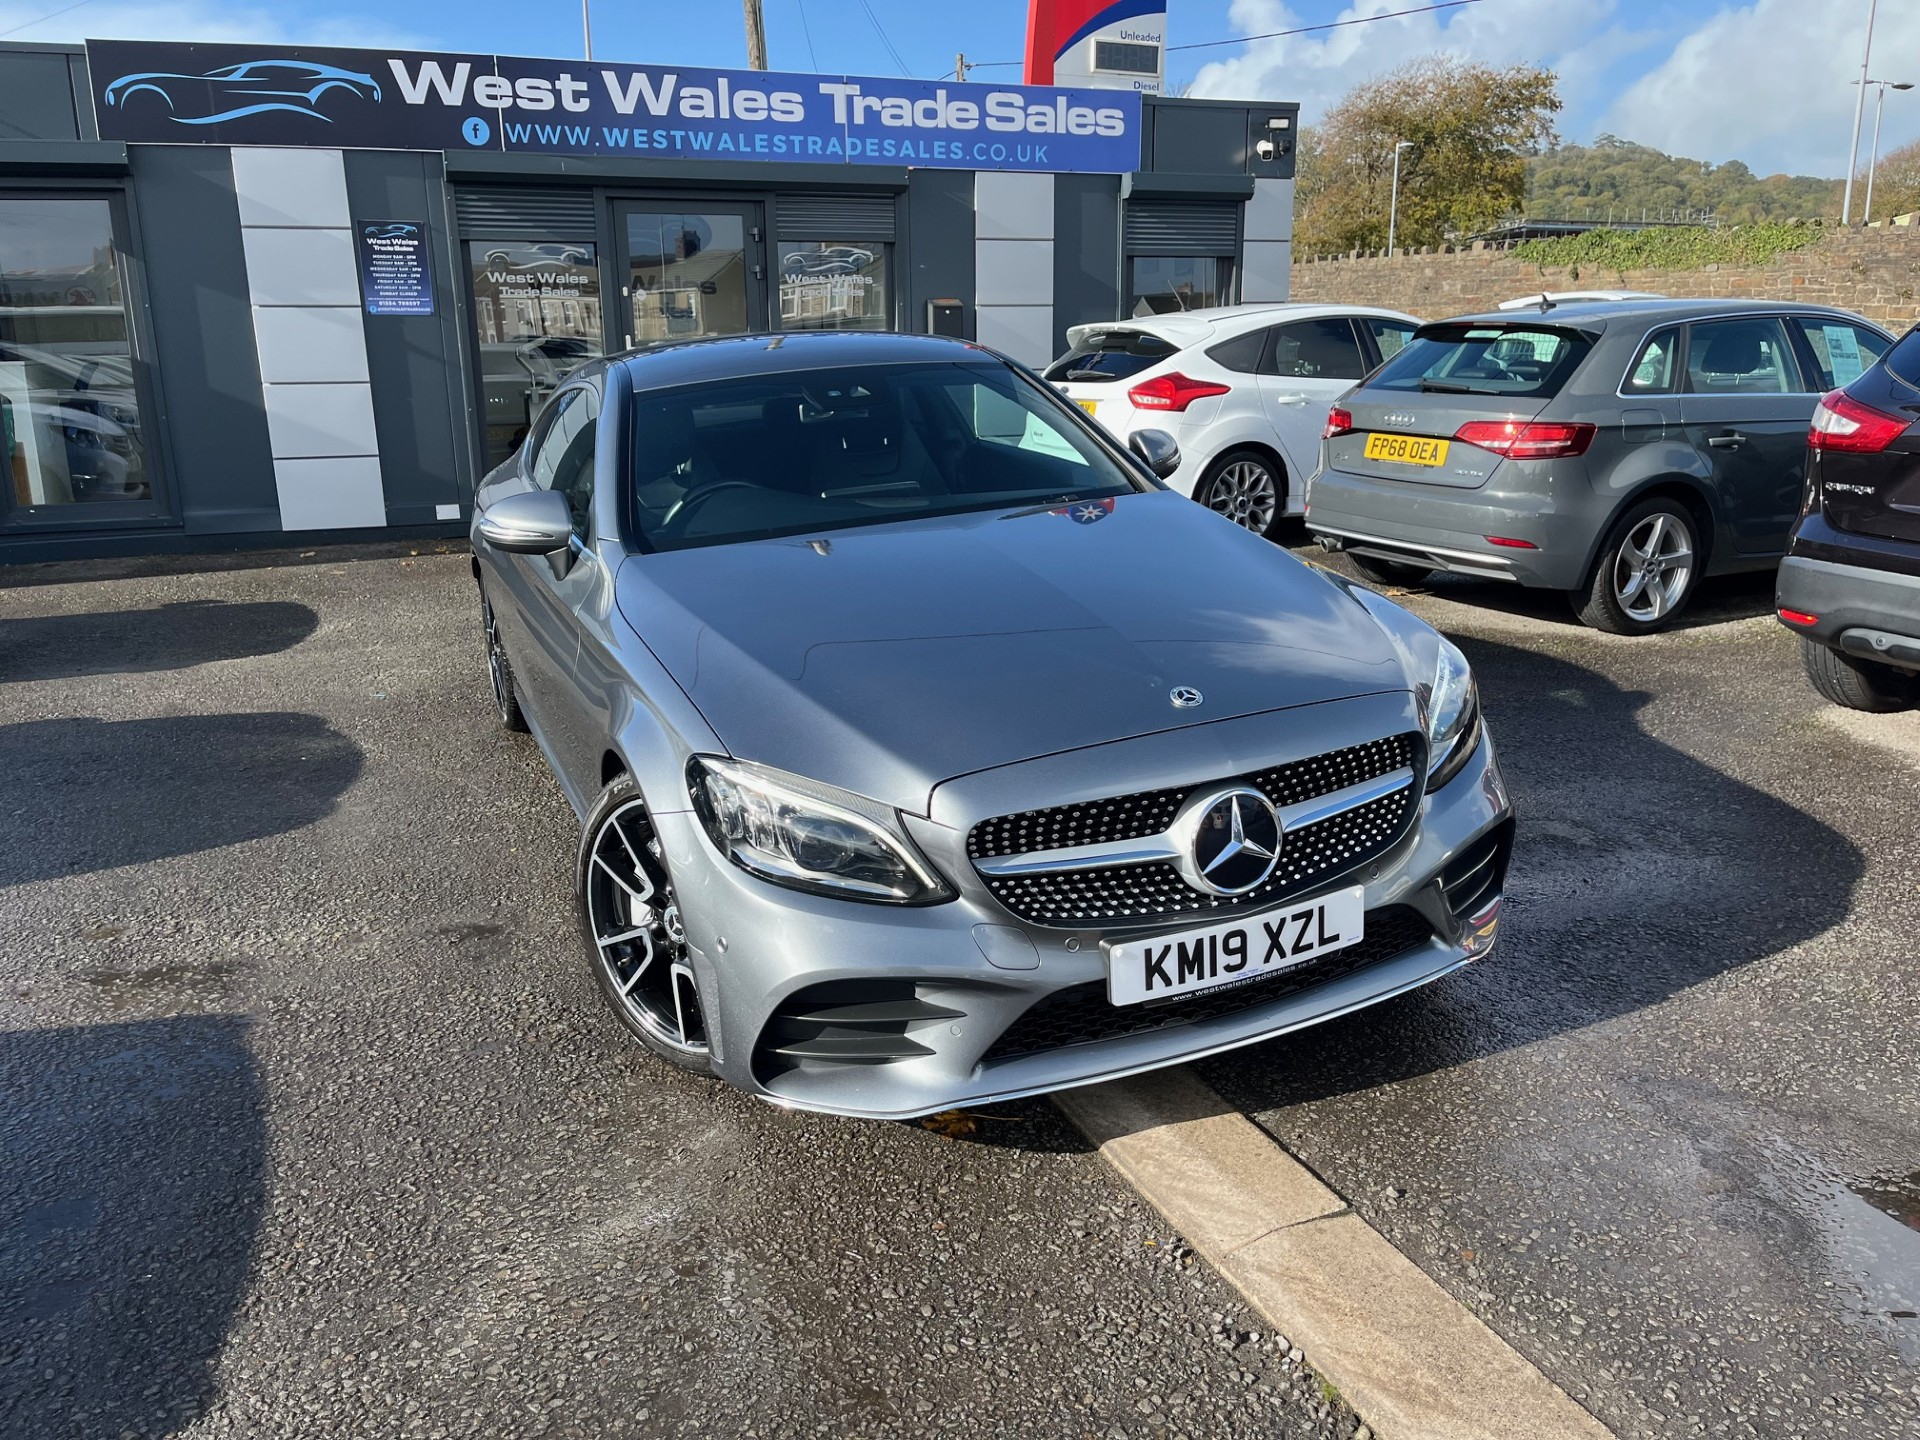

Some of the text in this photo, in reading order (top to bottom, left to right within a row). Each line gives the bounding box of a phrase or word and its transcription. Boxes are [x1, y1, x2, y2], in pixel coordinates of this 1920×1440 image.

[1120, 30, 1161, 43] Unleaded
[1133, 81, 1160, 91] Diesel
[387, 59, 1124, 137] West Wales Trade Sales
[505, 122, 1048, 164] WWW.WESTWALESTRADESALES.CO.UK
[391, 238, 419, 246] Wales
[487, 271, 589, 284] West Wales
[785, 273, 873, 284] West Wales
[499, 286, 580, 297] Trade Sales
[1370, 437, 1438, 462] FP68 OEA
[1144, 905, 1341, 992] KM19 XZL
[1171, 958, 1318, 1002] www.westwalestradesales.co.uk
